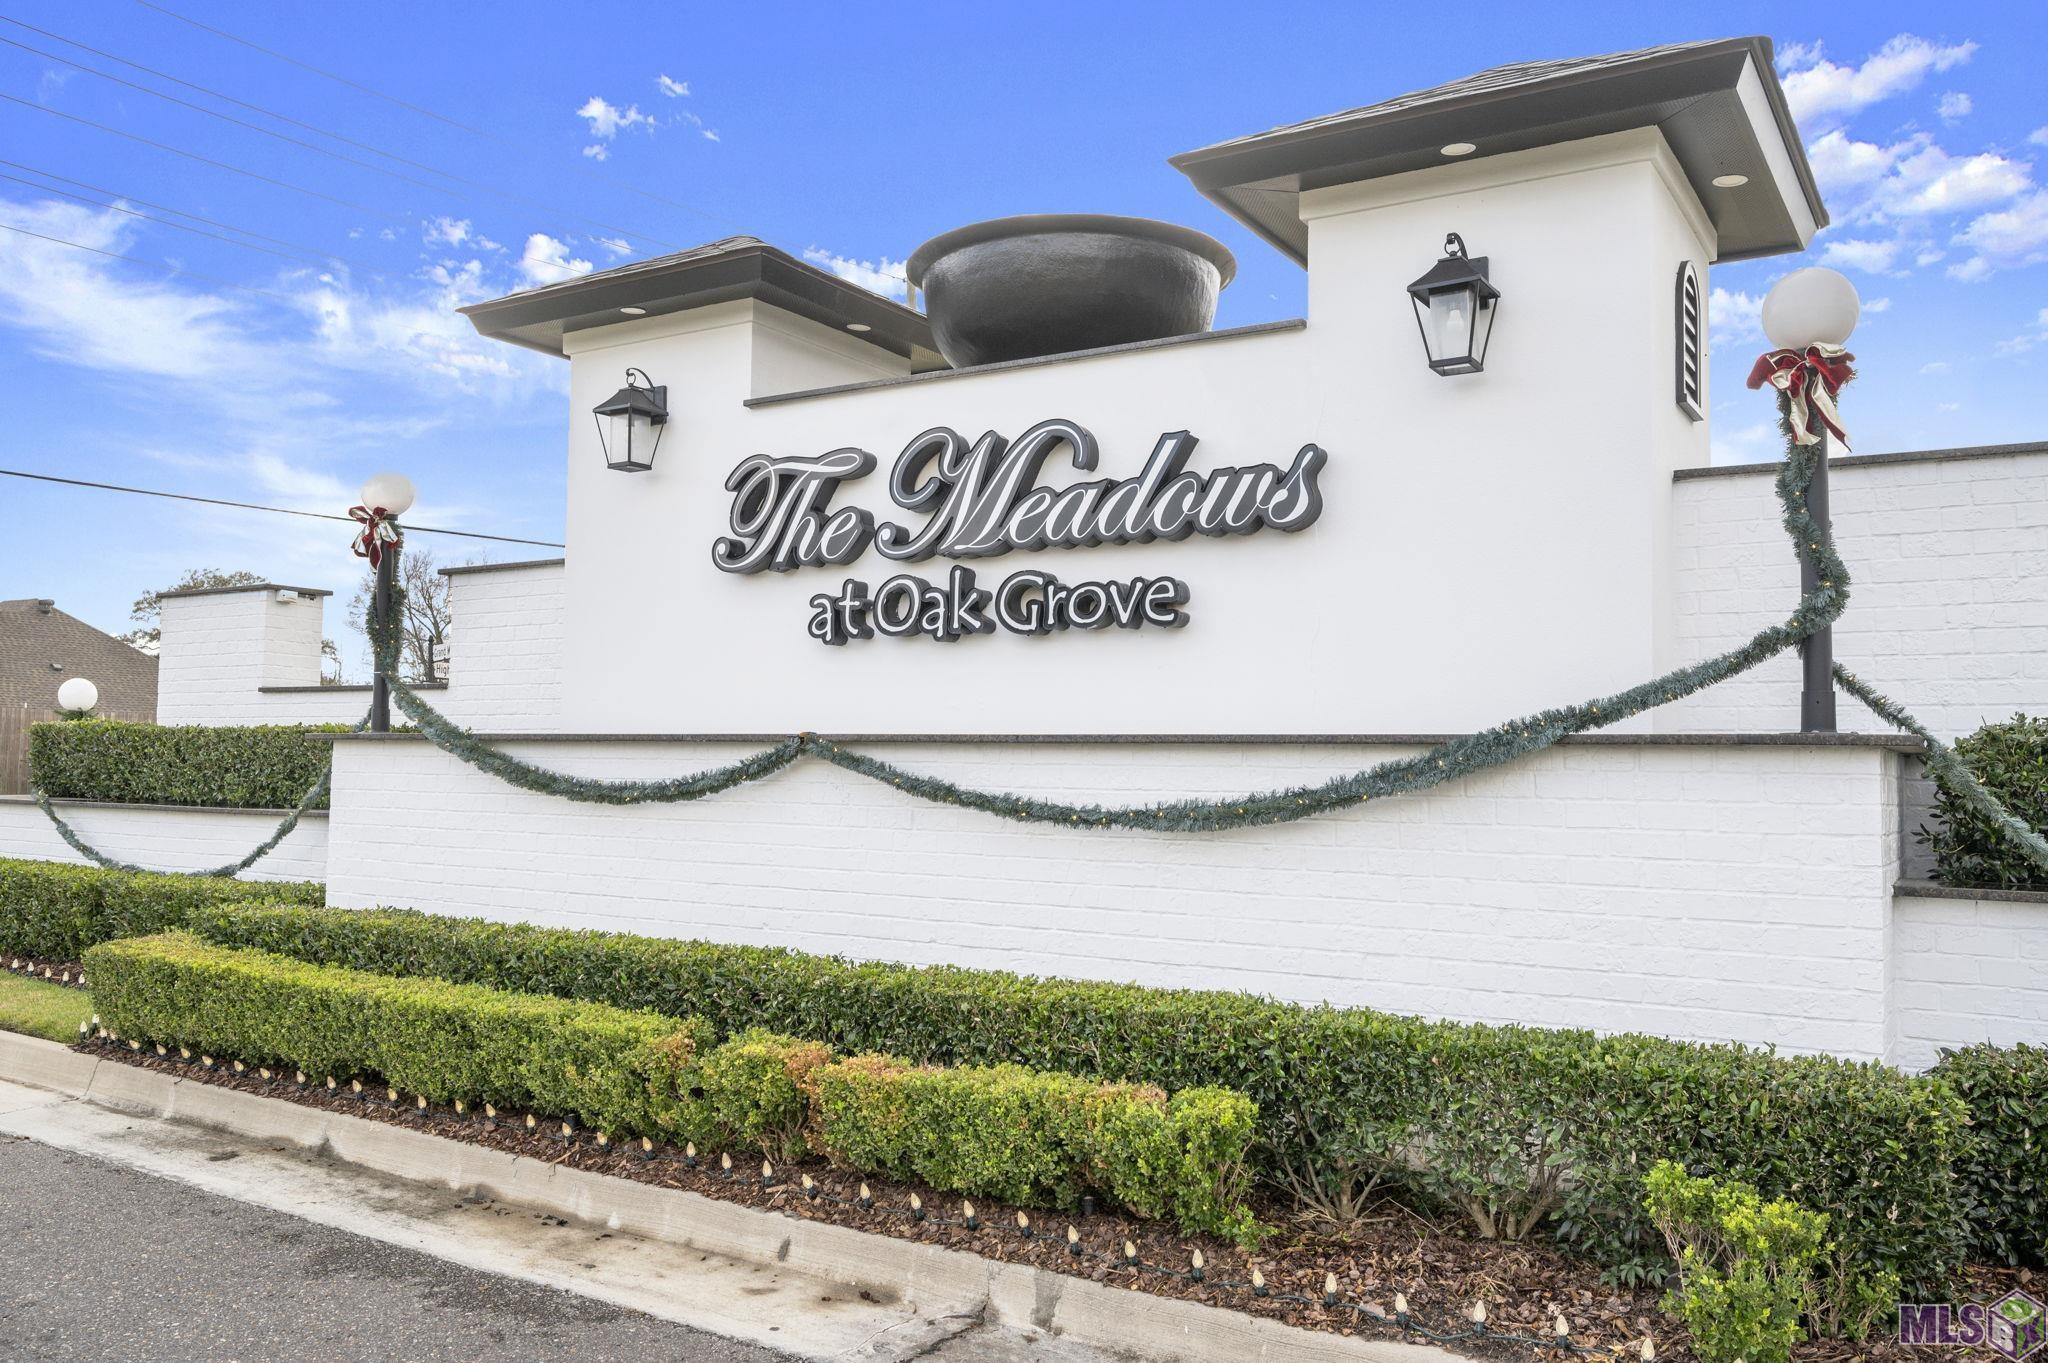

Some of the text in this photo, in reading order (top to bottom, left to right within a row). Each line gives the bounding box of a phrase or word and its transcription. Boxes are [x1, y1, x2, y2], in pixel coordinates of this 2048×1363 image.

[712, 418, 1328, 574] The Meadows
[808, 564, 1190, 645] at Oak Grove
